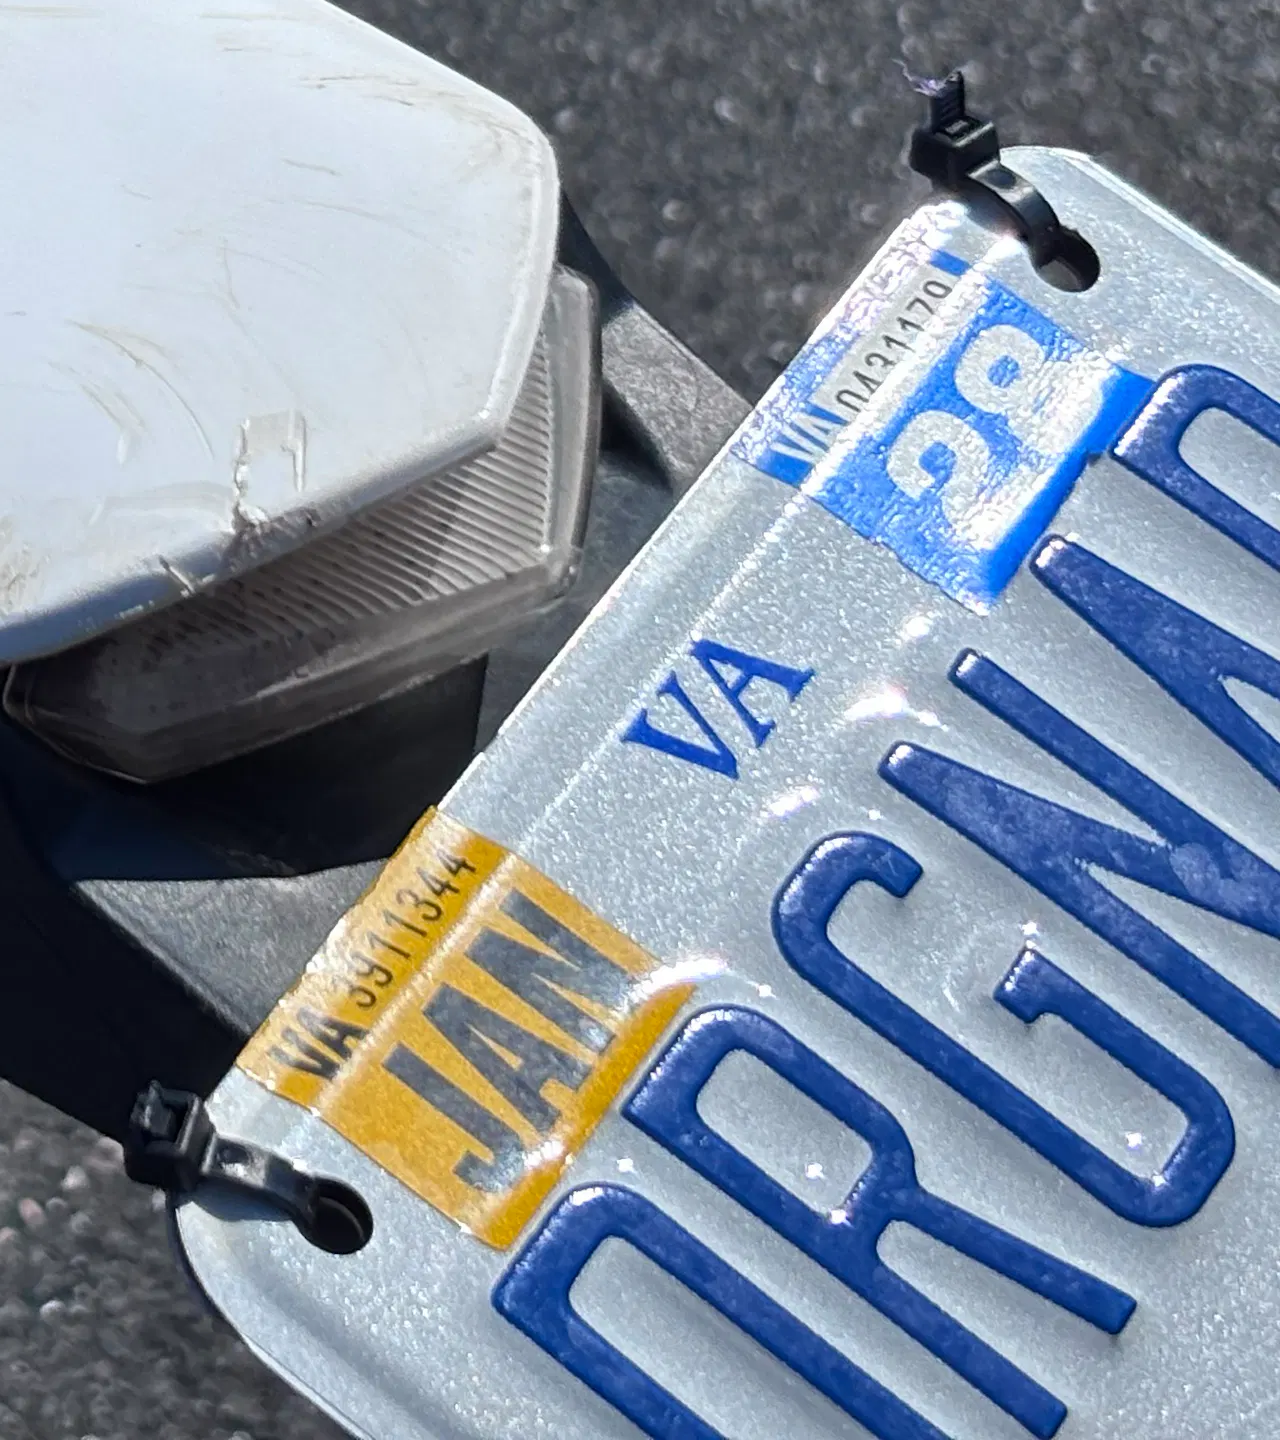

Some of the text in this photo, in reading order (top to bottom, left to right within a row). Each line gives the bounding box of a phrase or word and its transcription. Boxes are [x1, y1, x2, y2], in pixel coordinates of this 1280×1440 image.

[886, 323, 1104, 550] 28
[620, 637, 816, 780] VA
[268, 856, 477, 1080] VA 3911344
[383, 888, 650, 1193] JAN
